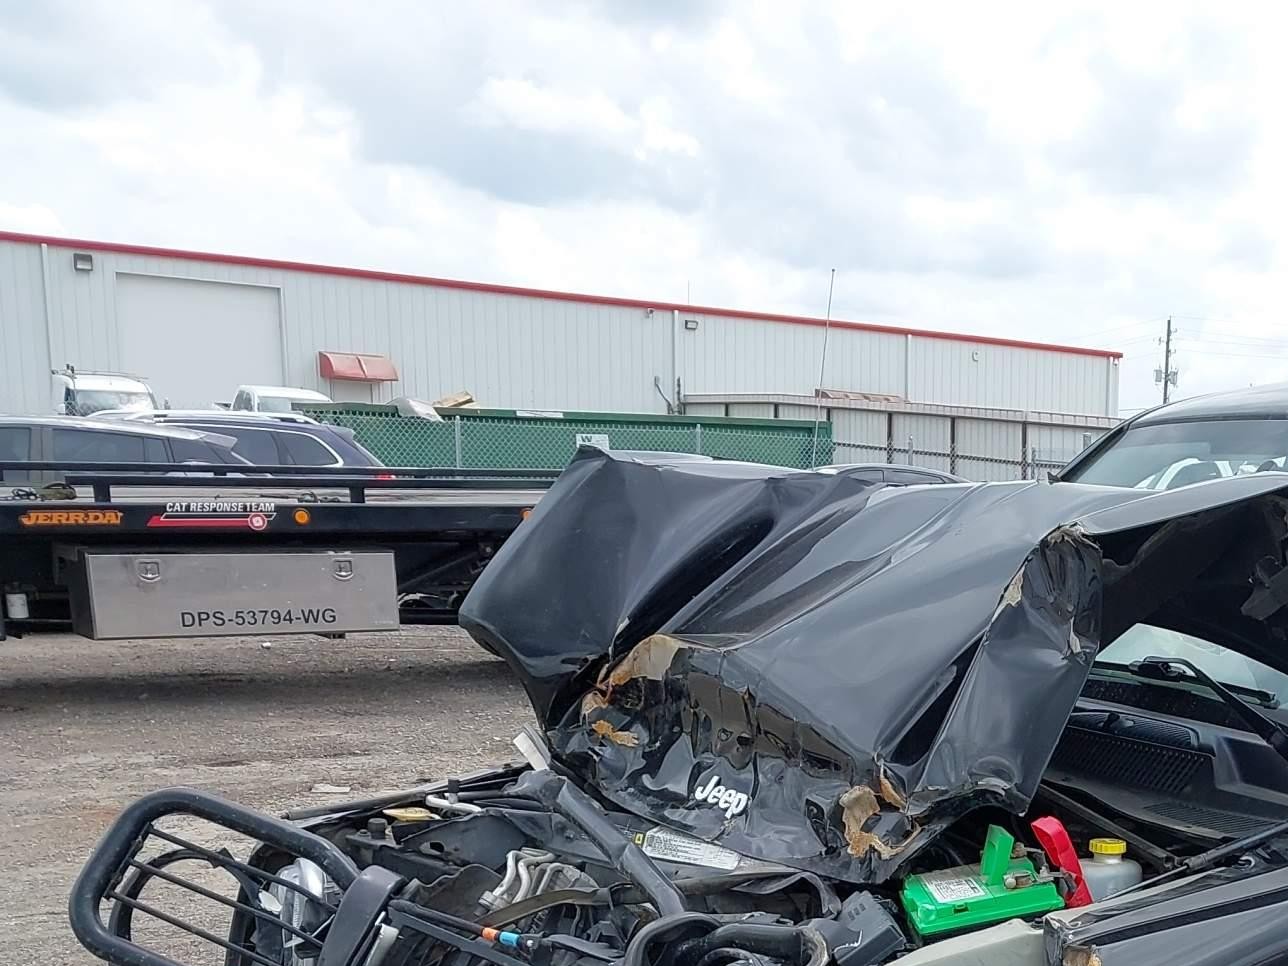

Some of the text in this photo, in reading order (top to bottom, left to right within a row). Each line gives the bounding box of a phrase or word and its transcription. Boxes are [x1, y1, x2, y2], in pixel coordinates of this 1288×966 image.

[166, 502, 275, 512] CAT RESPONSE TEAM
[181, 608, 337, 628] DPS-53794-WG
[694, 775, 750, 819] Jeep
